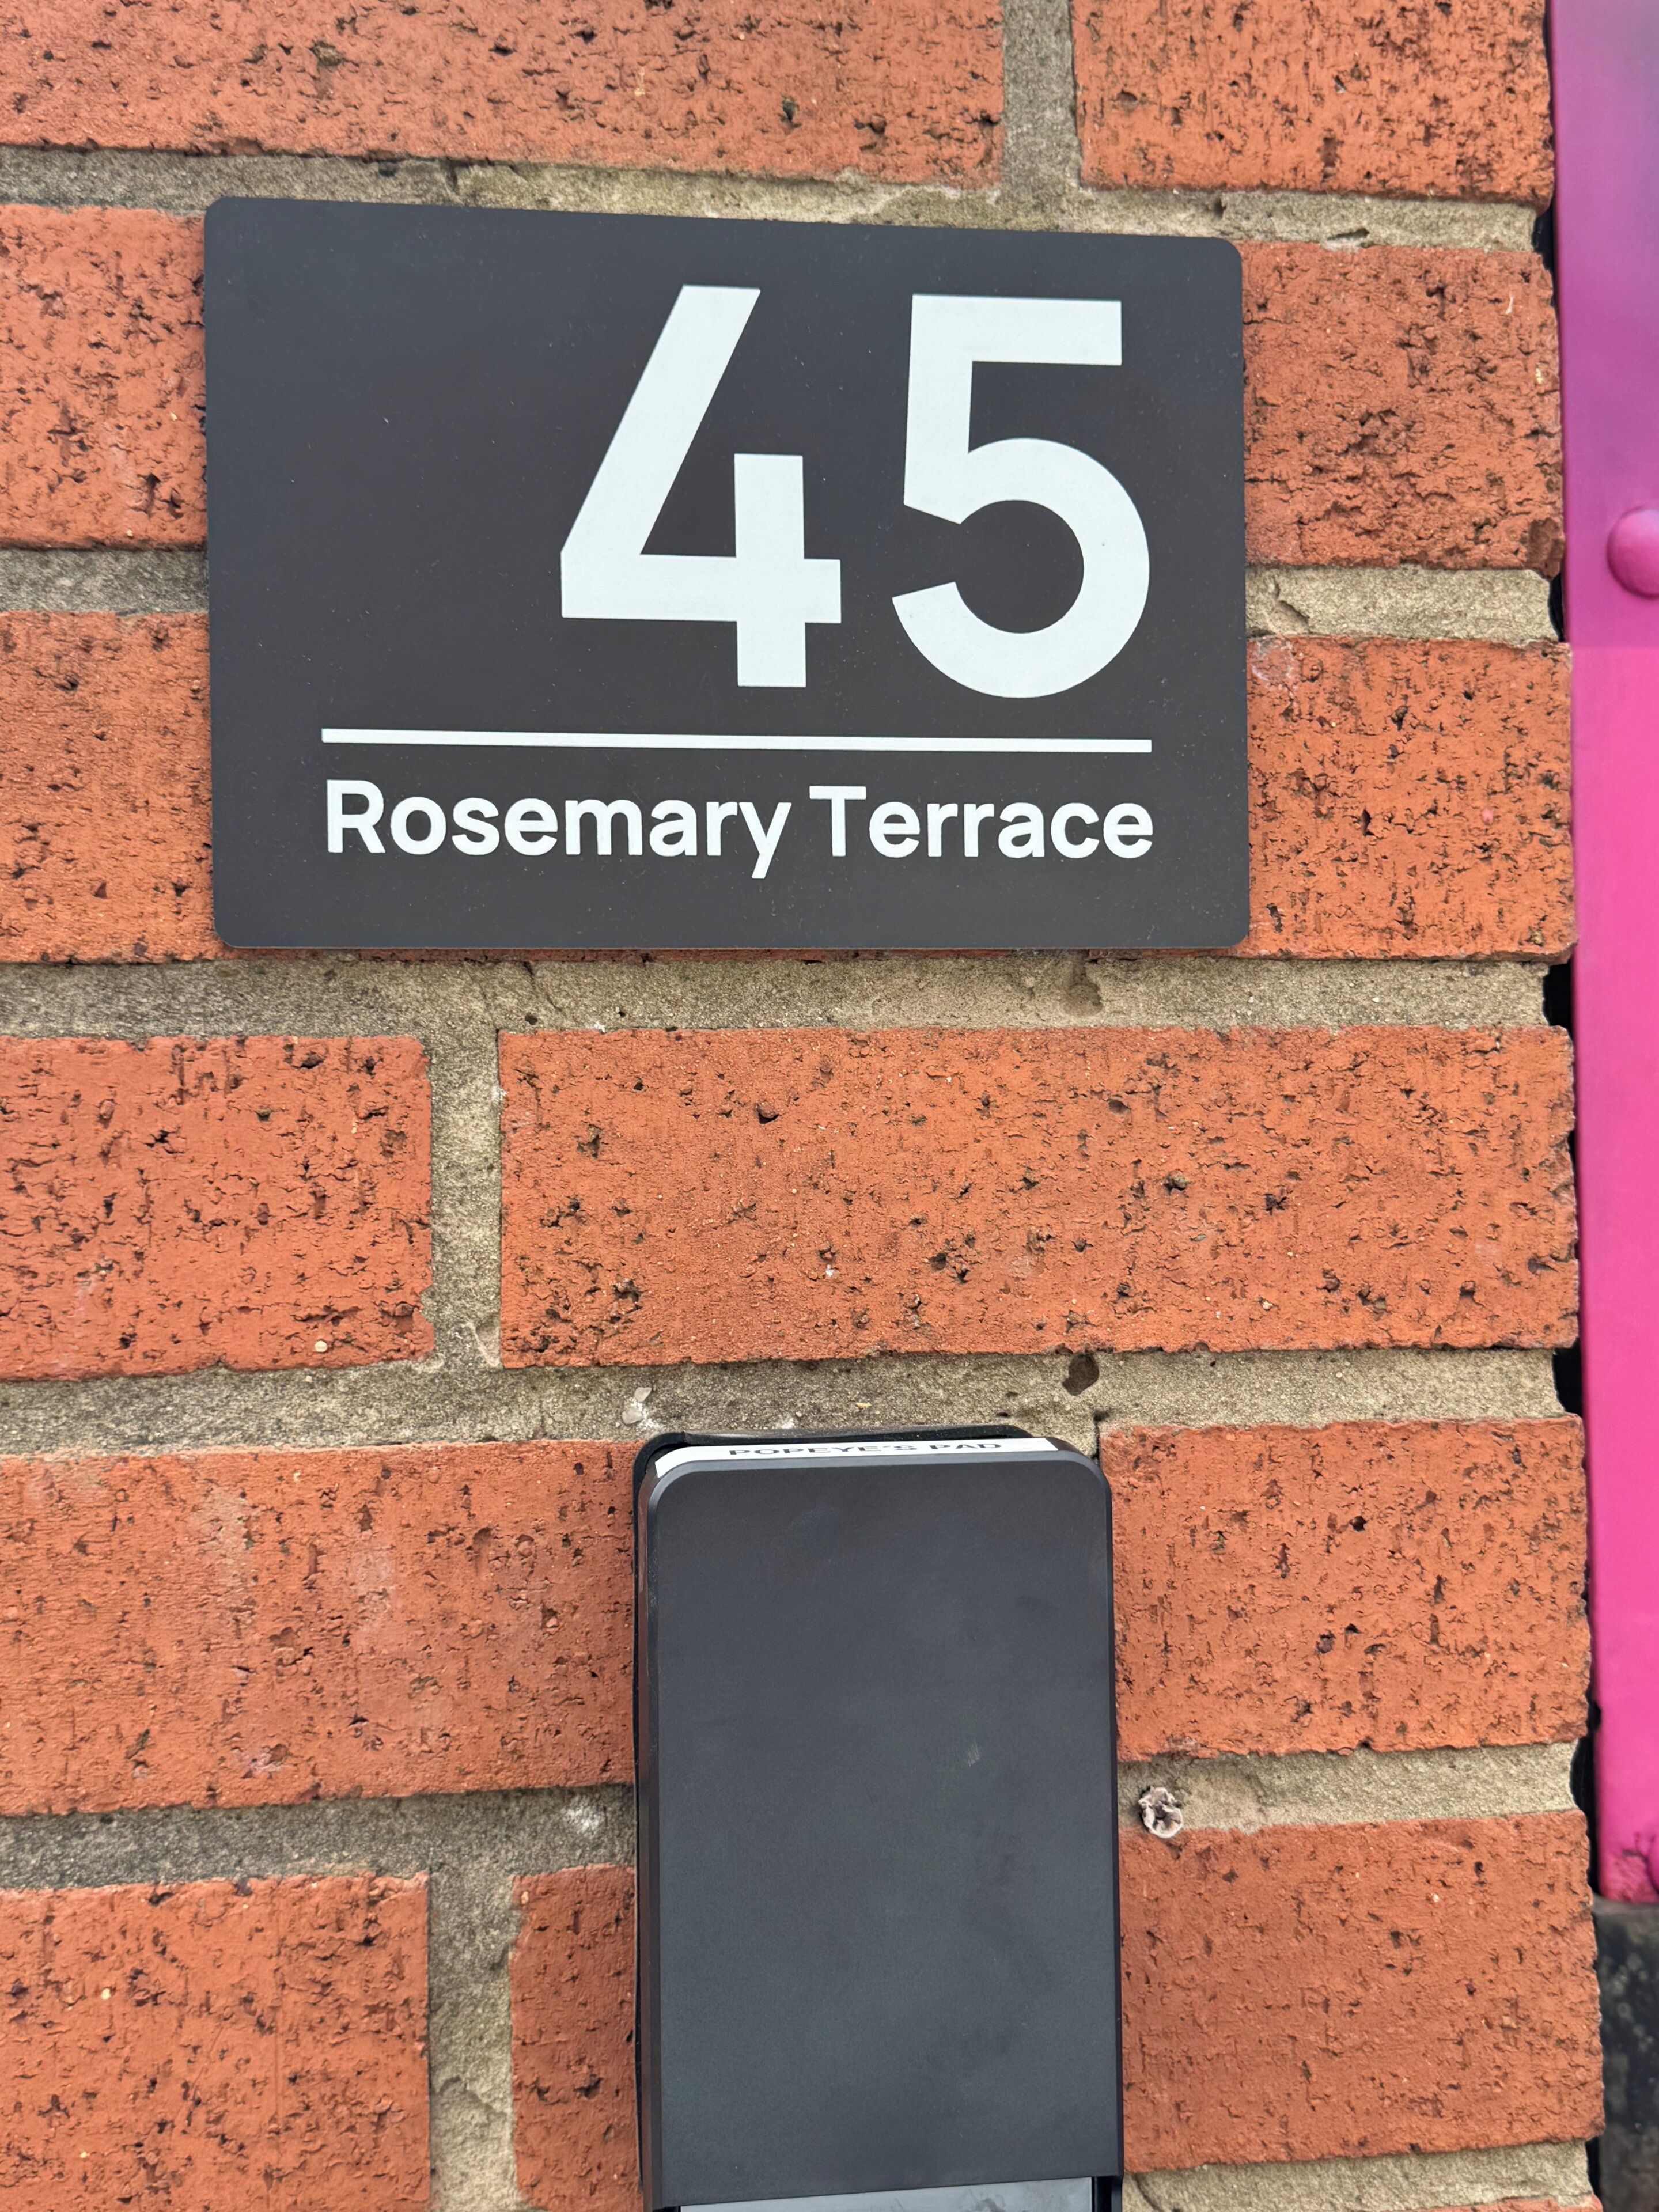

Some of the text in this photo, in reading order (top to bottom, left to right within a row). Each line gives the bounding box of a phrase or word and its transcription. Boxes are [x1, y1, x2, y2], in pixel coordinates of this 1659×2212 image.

[560, 285, 1150, 699] 45
[326, 779, 1154, 880] Rosemary Terrace
[729, 1445, 918, 1455] POPEYE'S
